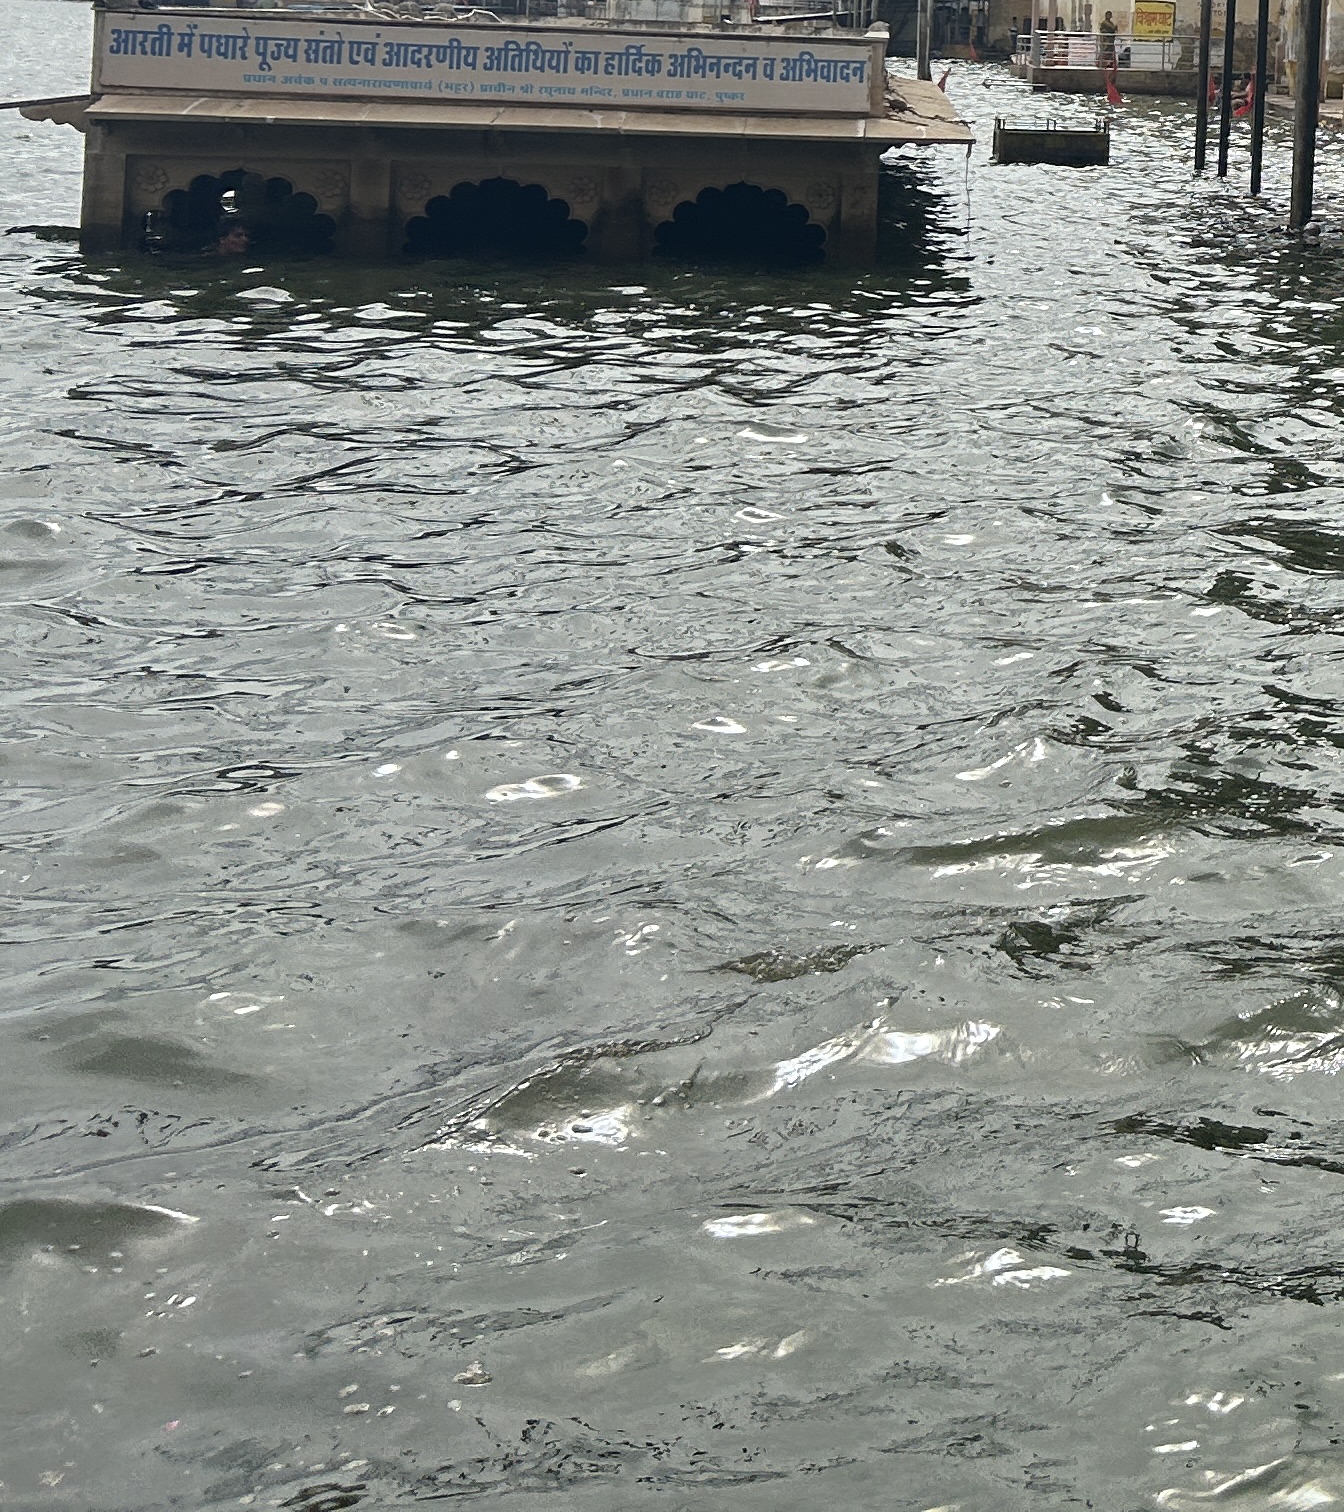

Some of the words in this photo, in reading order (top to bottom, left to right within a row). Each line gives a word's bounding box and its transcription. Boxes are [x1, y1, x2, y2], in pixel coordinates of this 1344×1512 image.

[109, 23, 174, 58] आरती
[177, 24, 198, 58] में
[199, 27, 250, 60] पधारे
[254, 36, 300, 72] पूज्य
[303, 31, 345, 65] संतो
[347, 33, 381, 67] एवं
[382, 38, 480, 70] आदरणीय
[483, 41, 573, 74] अतिथियों
[575, 50, 601, 75] का
[604, 44, 664, 78] हार्दिक
[667, 47, 761, 80] अभिनन्दन
[763, 57, 777, 80] व
[779, 51, 867, 84] अभिवादन
